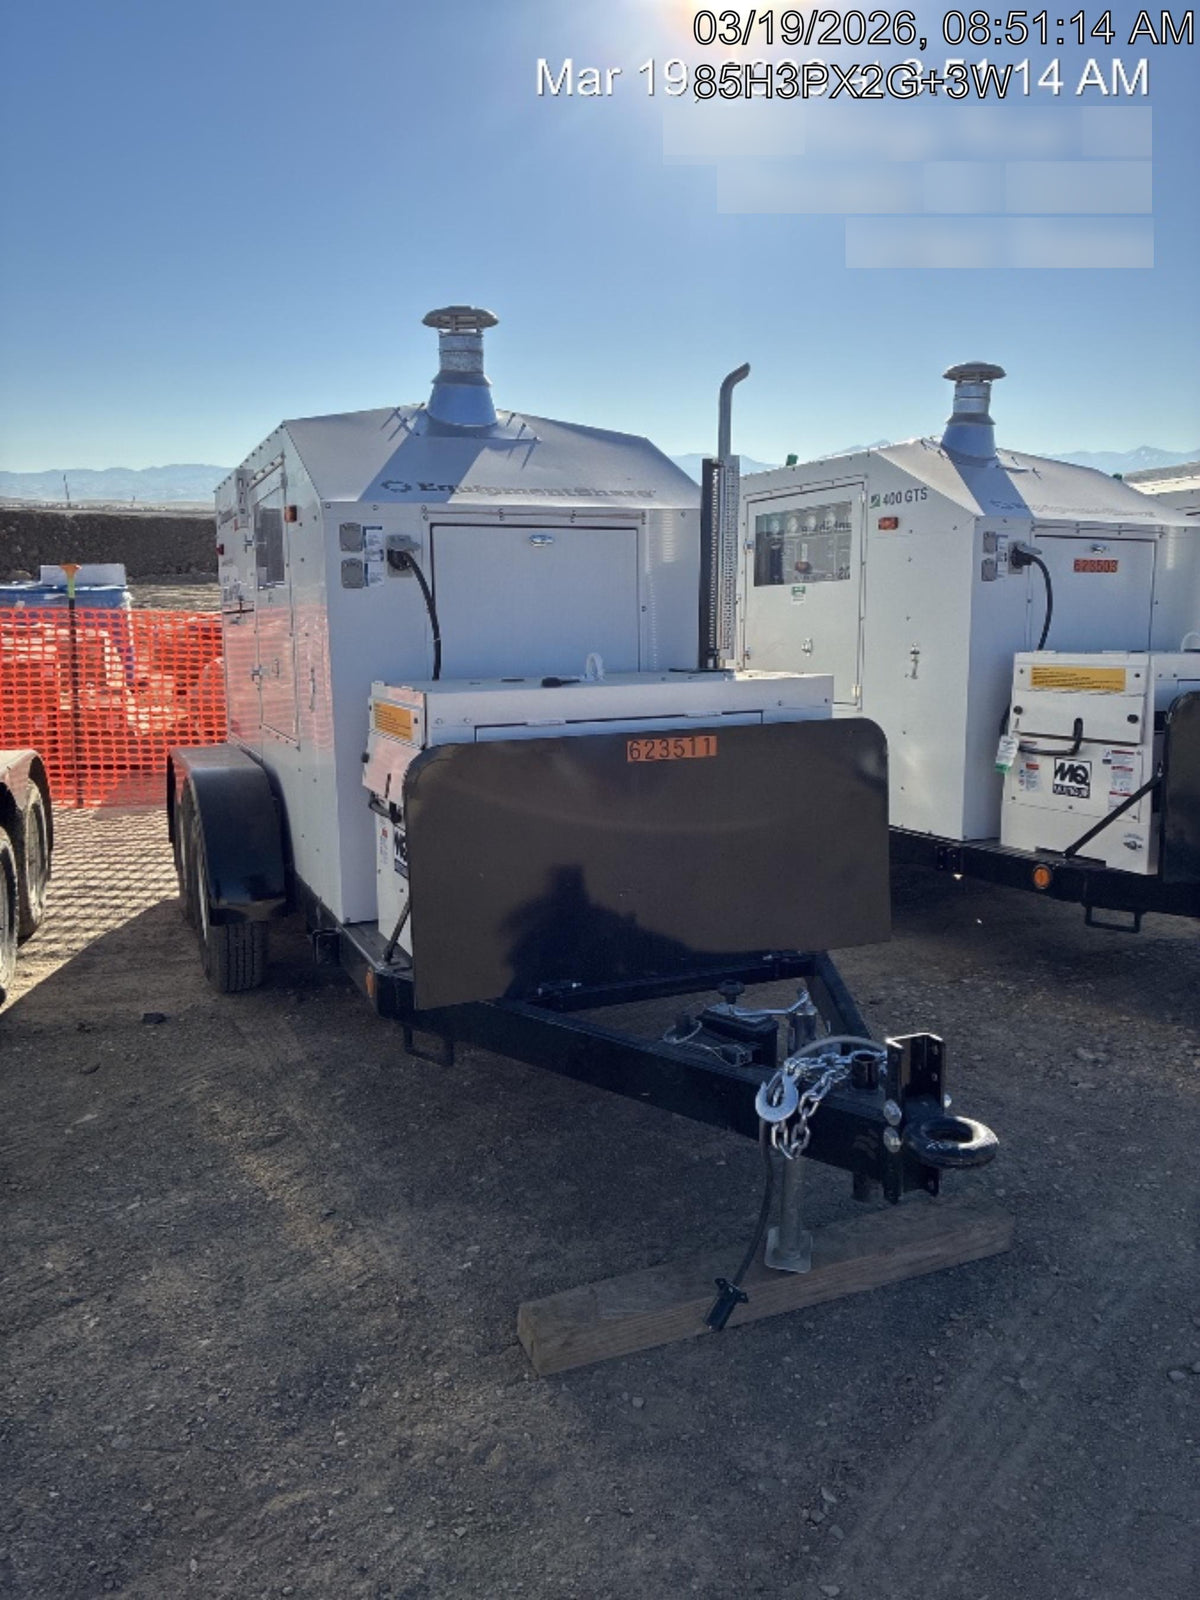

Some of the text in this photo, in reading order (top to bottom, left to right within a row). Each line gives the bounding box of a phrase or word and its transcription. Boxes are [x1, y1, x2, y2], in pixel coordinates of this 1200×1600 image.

[883, 487, 928, 505] 400 GTS
[630, 737, 711, 760] 623511
[1054, 762, 1089, 786] MQ
